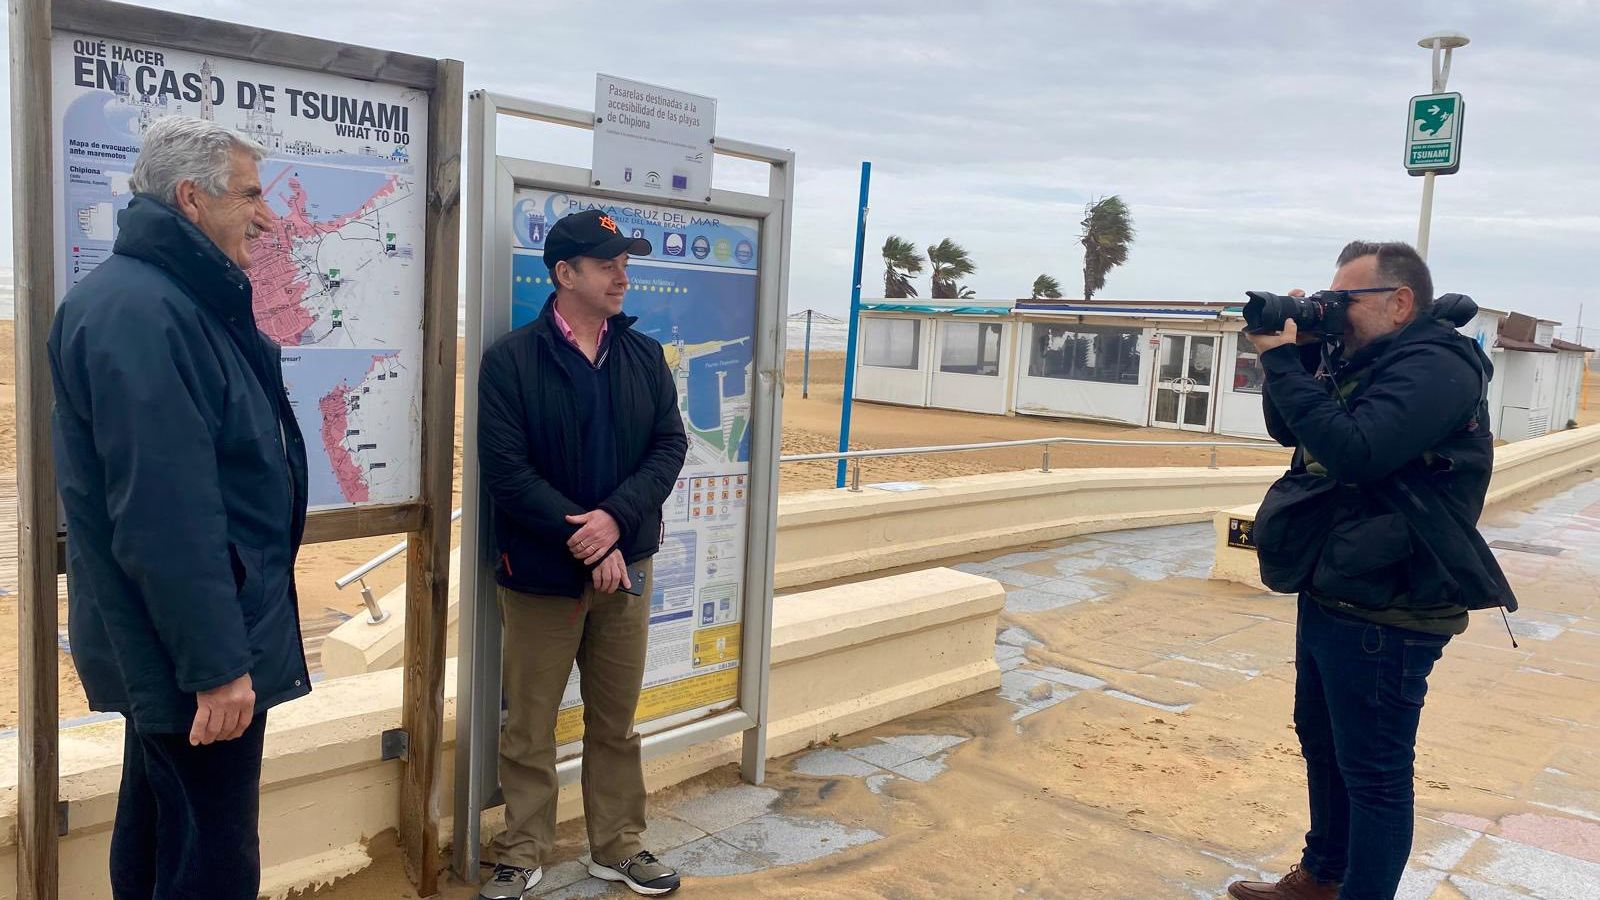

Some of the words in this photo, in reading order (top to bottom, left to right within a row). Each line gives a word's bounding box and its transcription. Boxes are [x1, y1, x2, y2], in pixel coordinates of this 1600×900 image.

[73, 39, 106, 58] QUÉ
[112, 45, 165, 67] HACER
[74, 55, 119, 91] EN
[135, 65, 225, 106] CASO
[237, 80, 276, 114] DE
[285, 87, 409, 132] TSUNAMI
[608, 84, 644, 101] Pasarelas
[645, 93, 683, 110] destinadas
[684, 103, 689, 111] a
[690, 101, 697, 113] la
[607, 100, 655, 117] accesibilidad
[656, 107, 666, 119] de
[667, 110, 678, 122] las
[679, 112, 700, 127] playas
[607, 112, 617, 123] de
[618, 113, 651, 129] Chipiona
[335, 123, 371, 141] WHAT
[374, 129, 390, 143] TO
[393, 131, 410, 145] DO
[69, 139, 90, 148] Mapa
[101, 144, 141, 153] evacuación
[1412, 149, 1449, 160] TSUNAMI
[87, 150, 127, 160] maremotos
[69, 165, 101, 175] Chipiona
[569, 199, 617, 215] PLAYA
[621, 206, 659, 221] CRUZ
[662, 212, 687, 224] DEL
[690, 215, 720, 228] MAR
[631, 218, 644, 226] DEL
[646, 220, 662, 228] MAR
[663, 221, 686, 230] BEACH
[280, 355, 301, 363] gresar?
